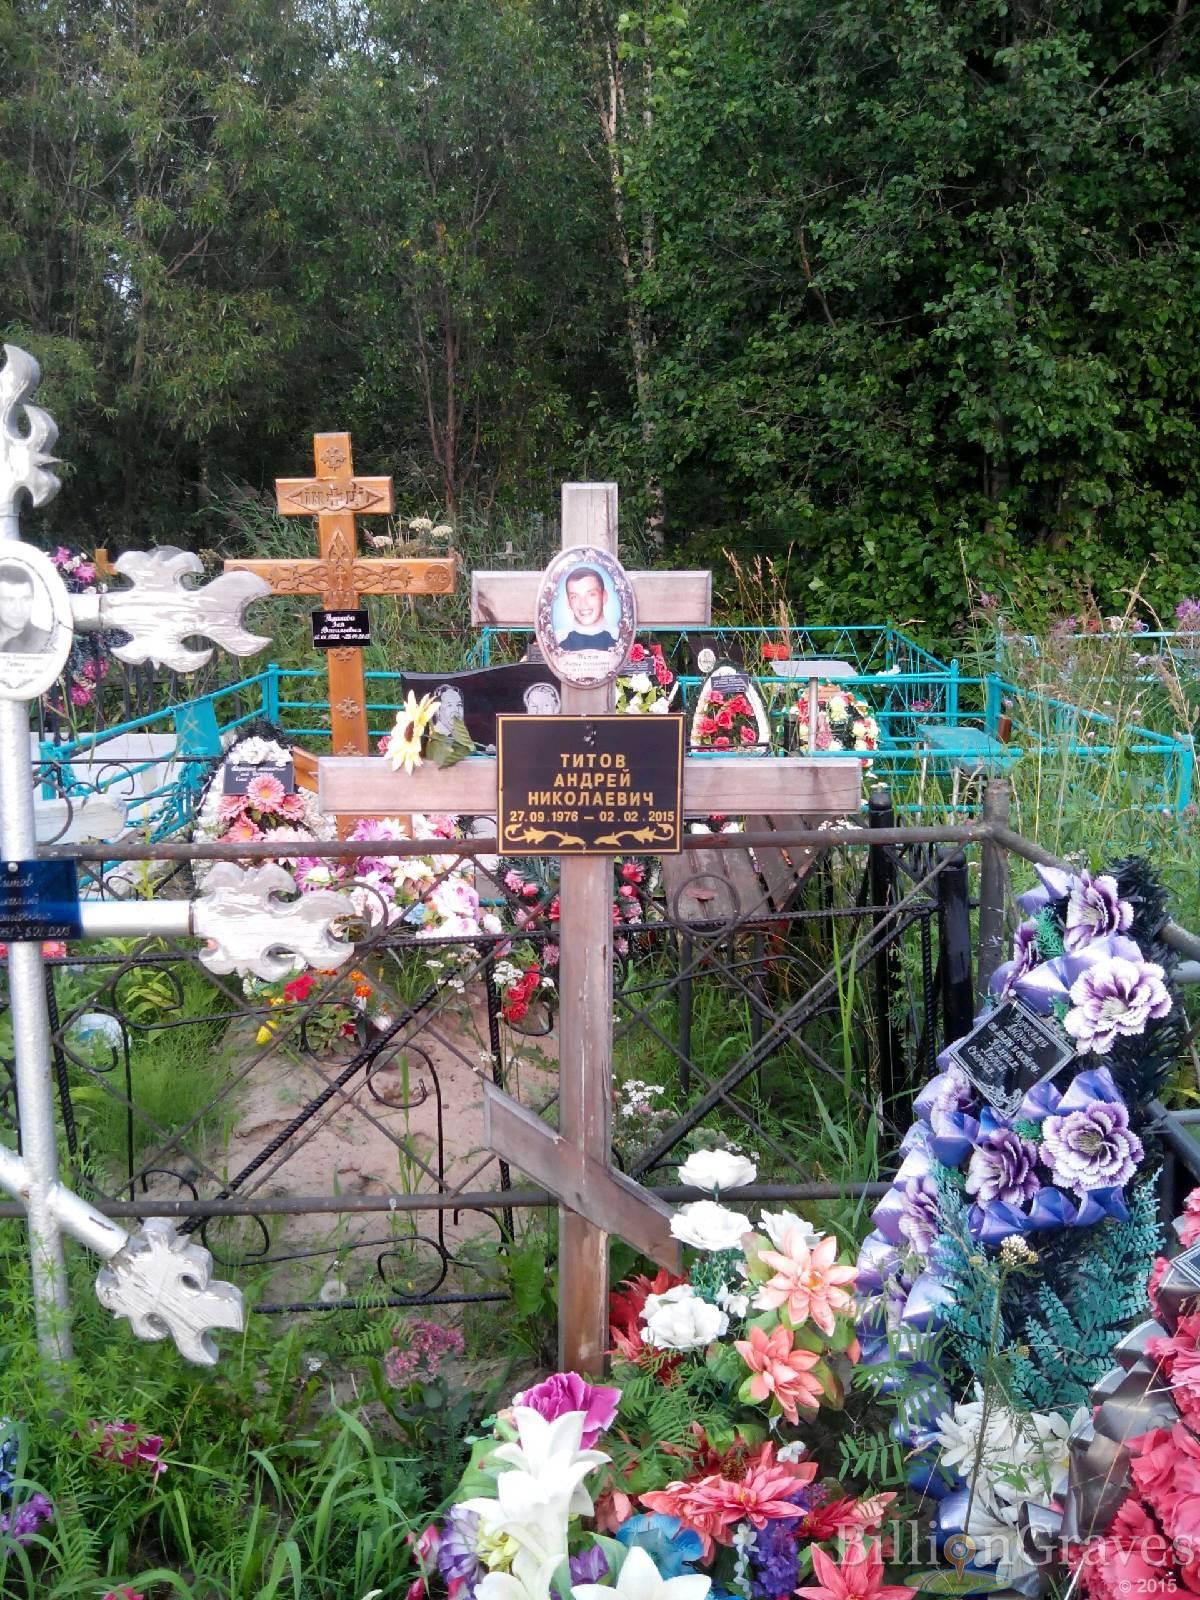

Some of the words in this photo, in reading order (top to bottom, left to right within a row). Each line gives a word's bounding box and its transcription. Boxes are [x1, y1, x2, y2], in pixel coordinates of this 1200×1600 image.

[560, 753, 626, 768] ТИТОВ
[553, 768, 632, 789] АНДРЕЙ
[528, 791, 654, 806] НИКОЛАЕВИЧ
